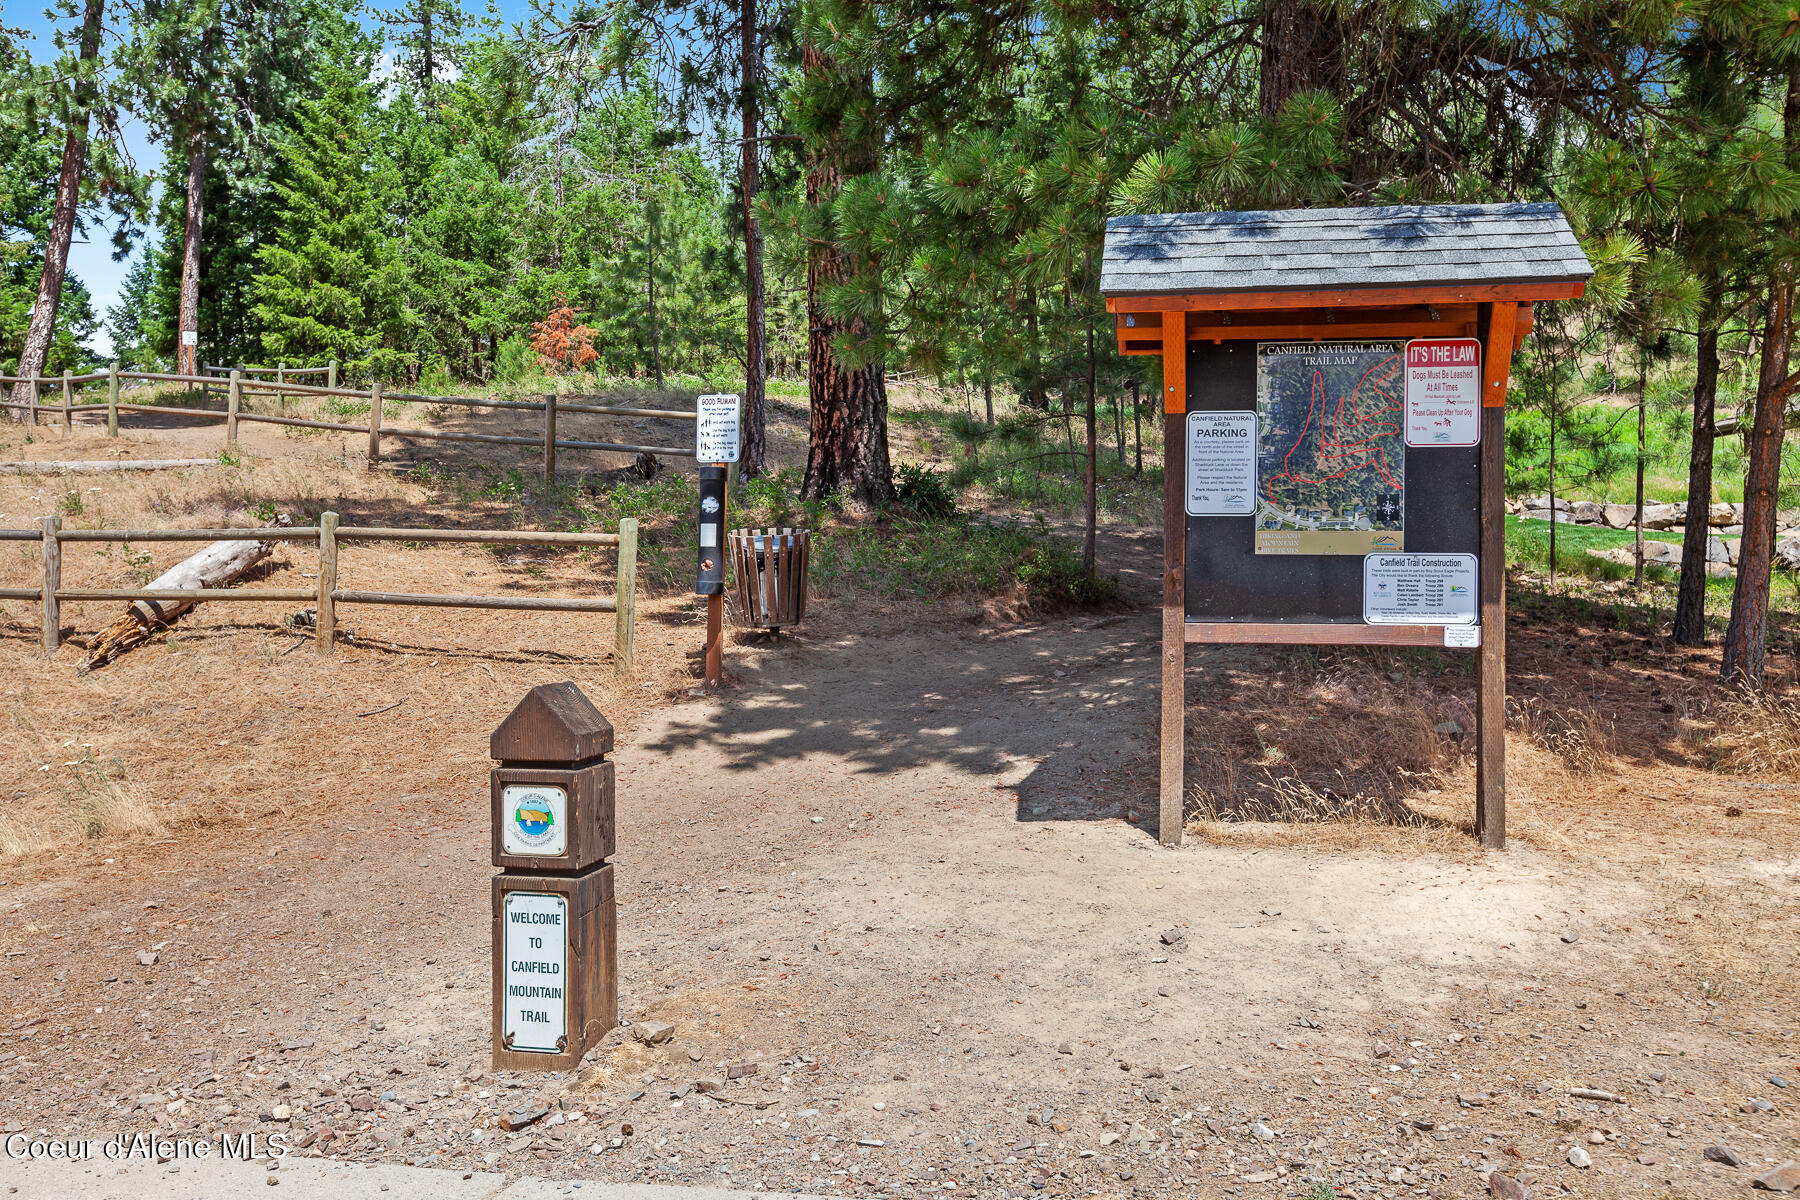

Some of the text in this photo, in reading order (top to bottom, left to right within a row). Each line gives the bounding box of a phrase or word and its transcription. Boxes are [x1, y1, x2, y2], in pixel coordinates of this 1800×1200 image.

[1266, 344, 1395, 354] CANFIELD NATURAL AREA
[1410, 346, 1476, 362] IT'S THE LAW
[1303, 356, 1358, 366] TRAIL MAP
[1412, 370, 1472, 381] Dogs Must Be Leashed
[1426, 384, 1432, 392] At
[1442, 383, 1458, 391] Times
[1464, 409, 1472, 417] Dog
[1197, 429, 1248, 438] PARKING
[1380, 558, 1461, 567] Canfield Trail Construction
[510, 912, 560, 925] WELCOME
[529, 937, 542, 949] TO
[512, 961, 559, 974] CANFIELD
[509, 985, 562, 999] MOUNTAIN
[520, 1010, 550, 1023] TRAIL
